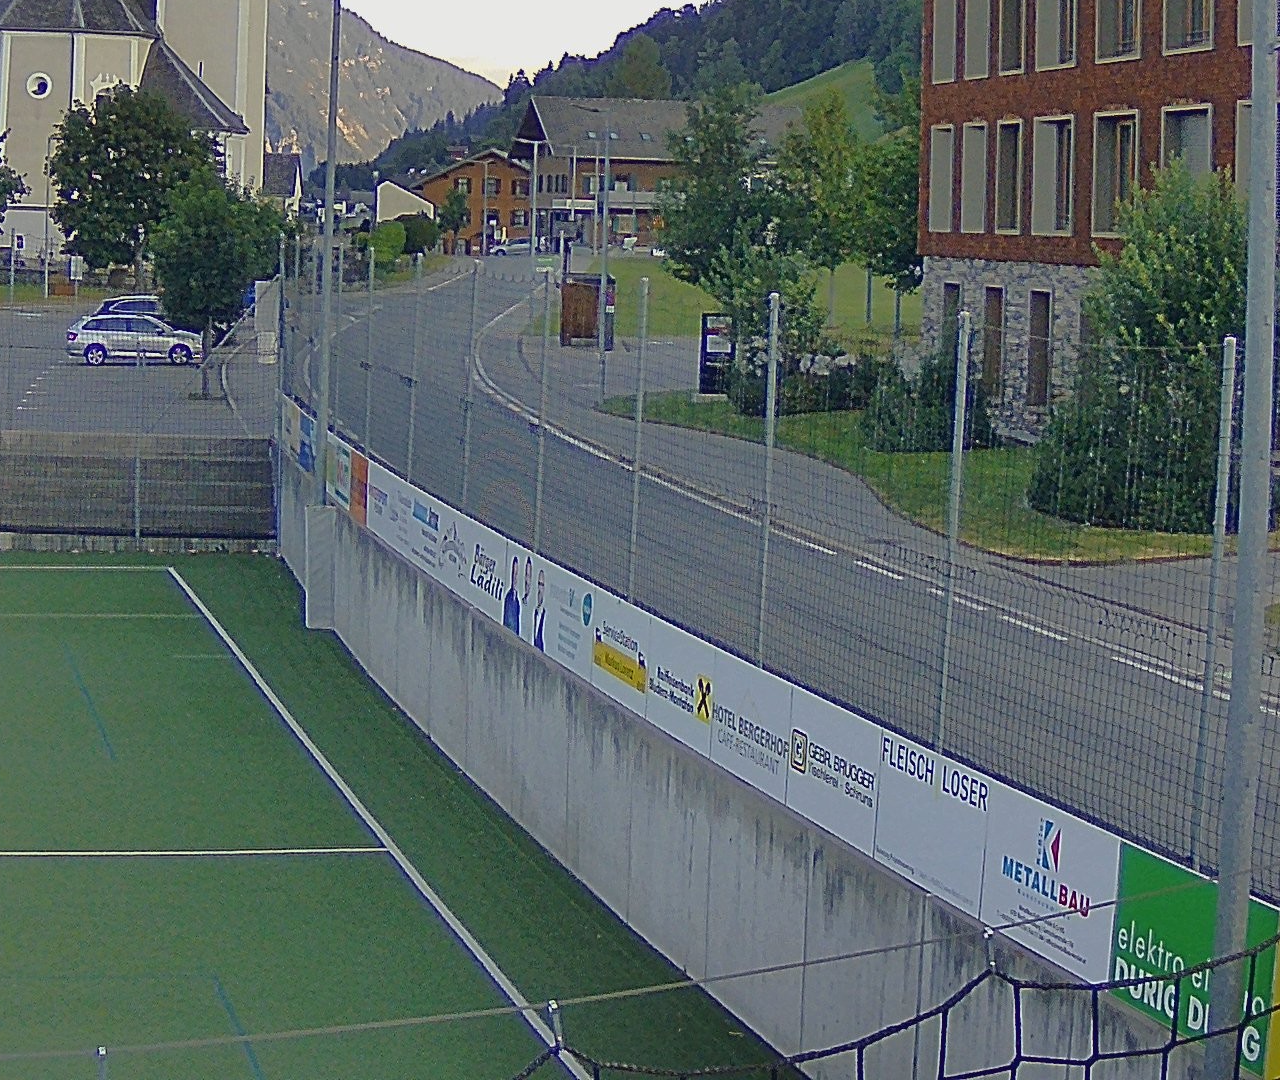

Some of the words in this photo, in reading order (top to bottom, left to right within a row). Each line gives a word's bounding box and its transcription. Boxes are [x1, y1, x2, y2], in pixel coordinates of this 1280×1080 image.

[712, 702, 737, 732] HOTEL
[844, 781, 874, 808] Schruns
[881, 737, 935, 786] FLEISCH
[941, 765, 989, 812] LOSER
[1002, 855, 1090, 918] METALLBAU
[1118, 920, 1185, 973] elektro
